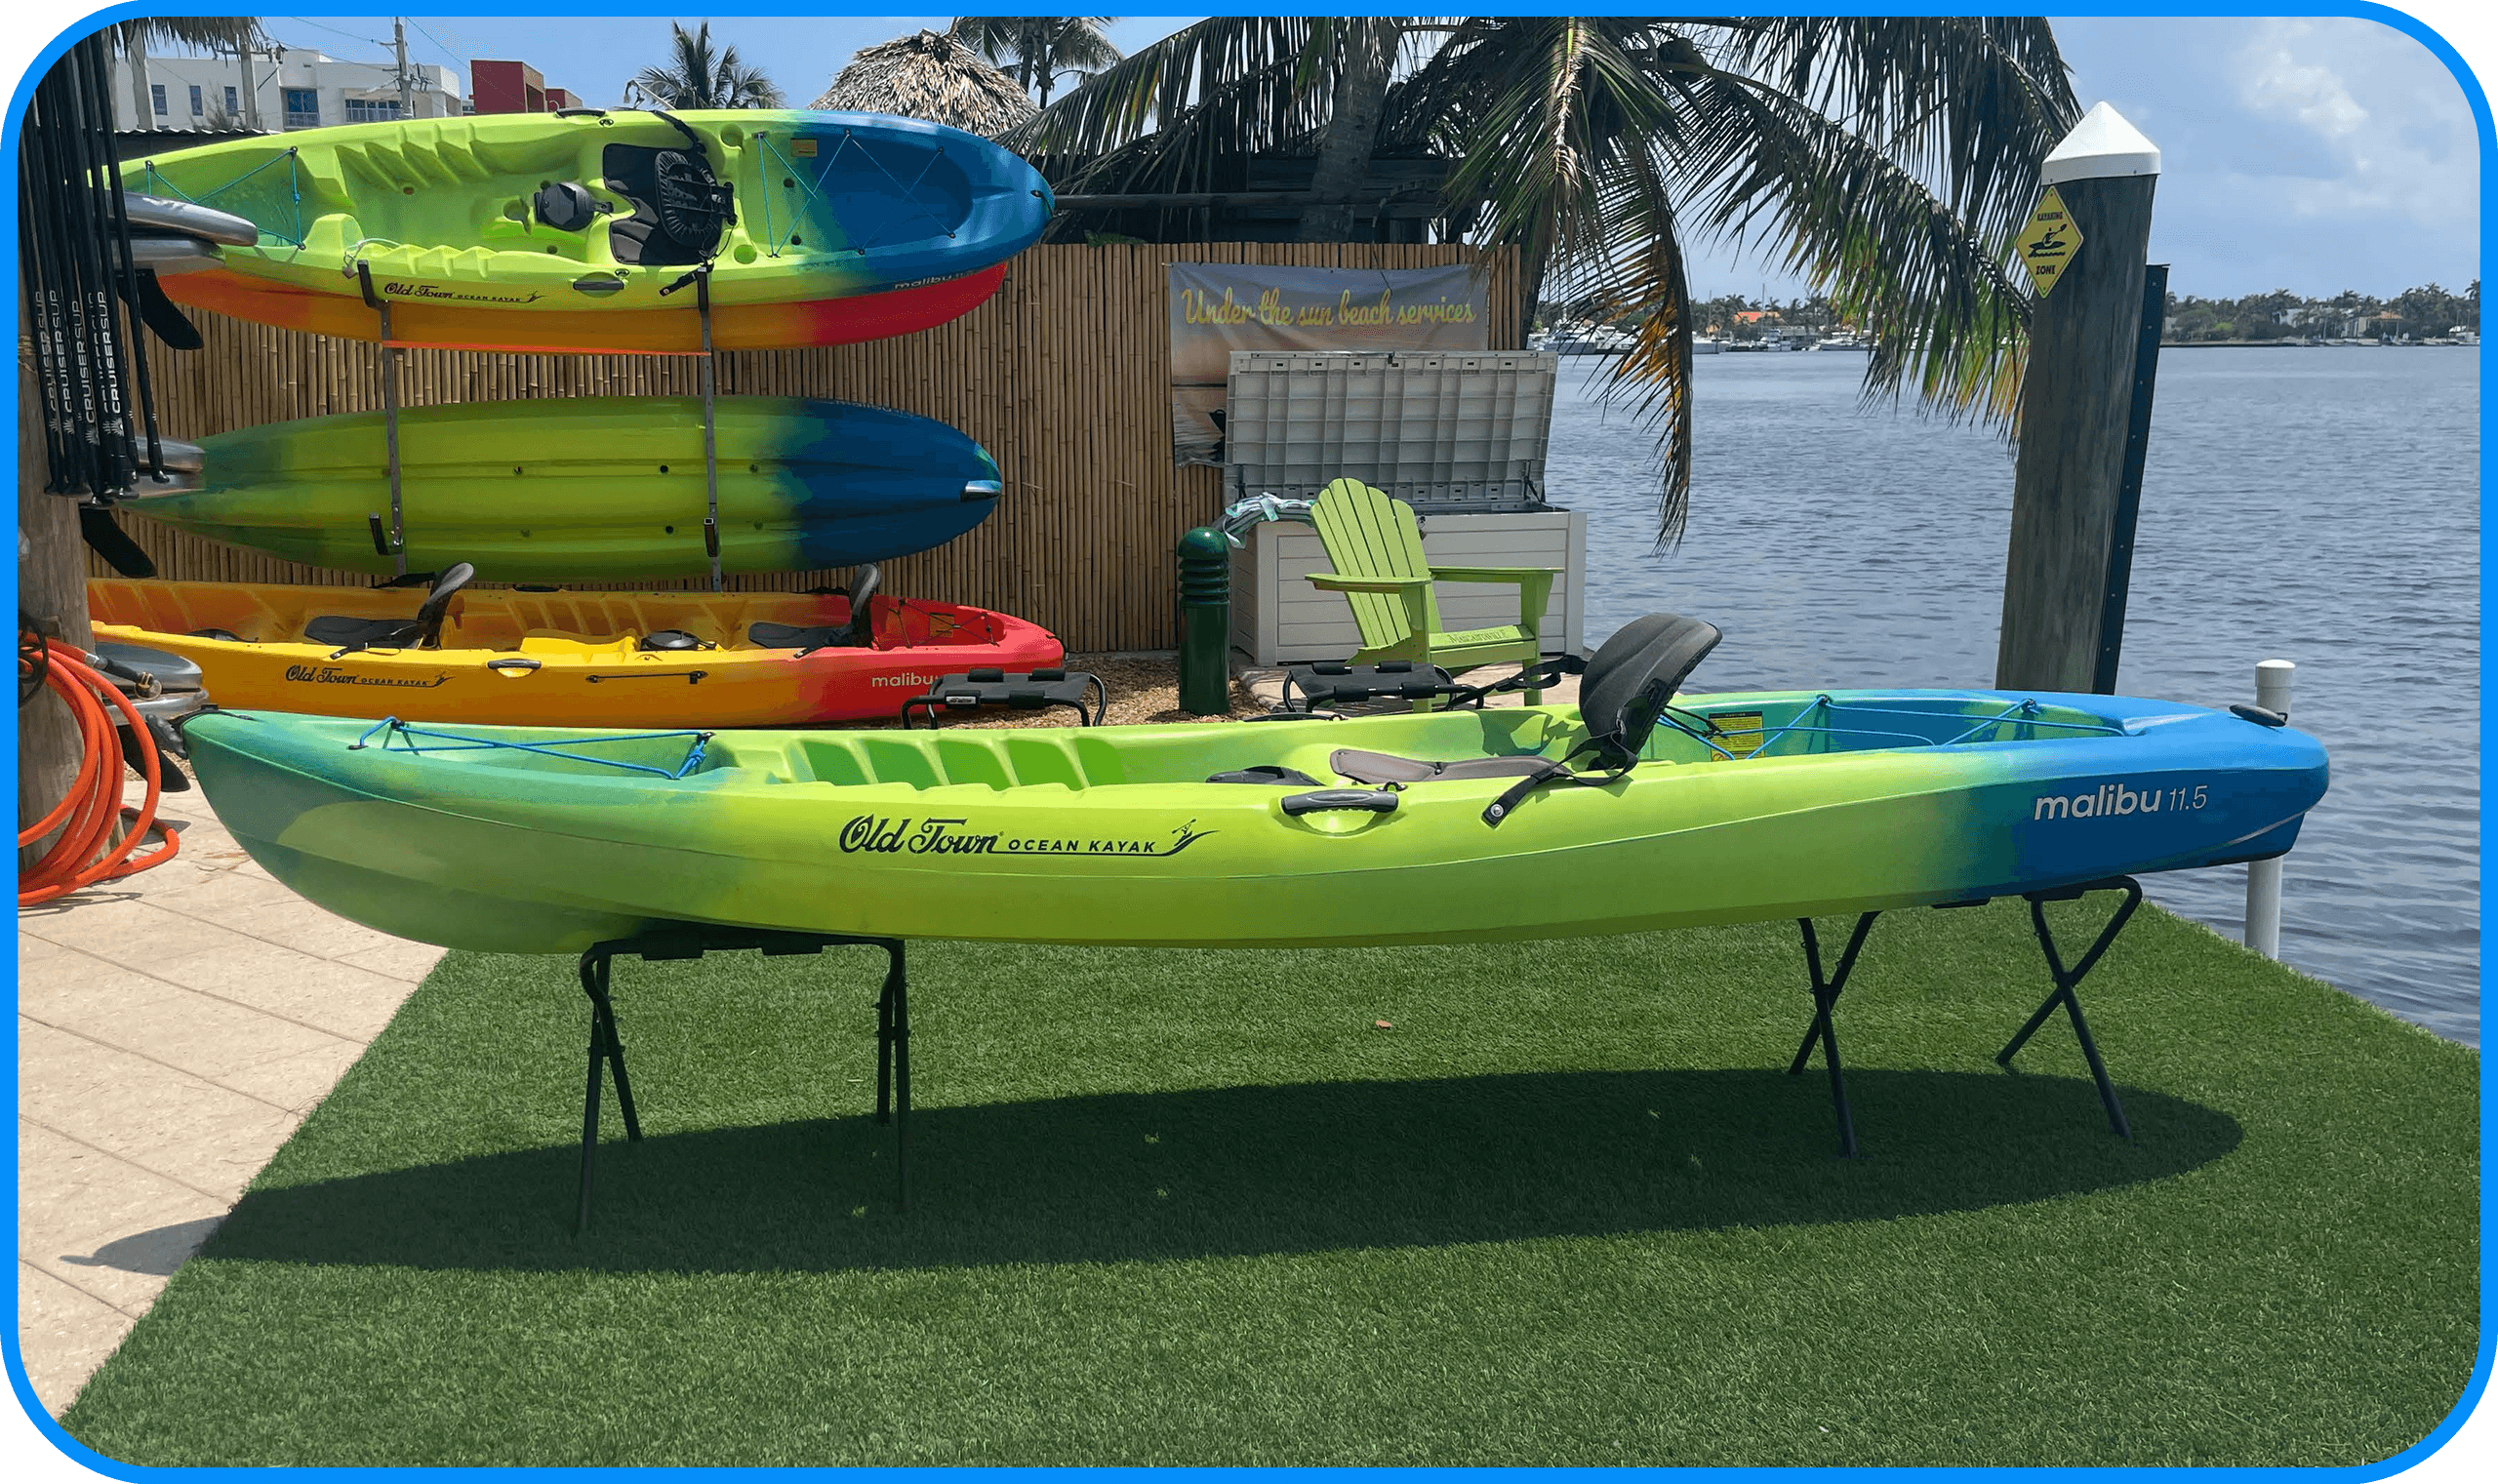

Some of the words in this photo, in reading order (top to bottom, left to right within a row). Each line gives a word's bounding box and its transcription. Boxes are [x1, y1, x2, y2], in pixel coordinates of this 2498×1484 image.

[2035, 264, 2056, 275] ZONE
[383, 282, 415, 297] Old
[414, 284, 454, 300] Town
[894, 274, 952, 290] malibu
[1181, 286, 1256, 325] Under
[1258, 287, 1295, 326] the
[1297, 305, 1334, 326] sun
[1338, 288, 1394, 326] beach
[1395, 296, 1477, 325] services
[285, 664, 317, 682] Old
[316, 666, 358, 684] Town
[871, 671, 933, 688] malibu
[2034, 783, 2162, 821] malibu
[2169, 784, 2208, 812] 11.5
[838, 814, 911, 855] Old
[907, 818, 999, 855] Town
[1008, 838, 1079, 852] OCEAN
[1089, 840, 1156, 854] KAYAK
